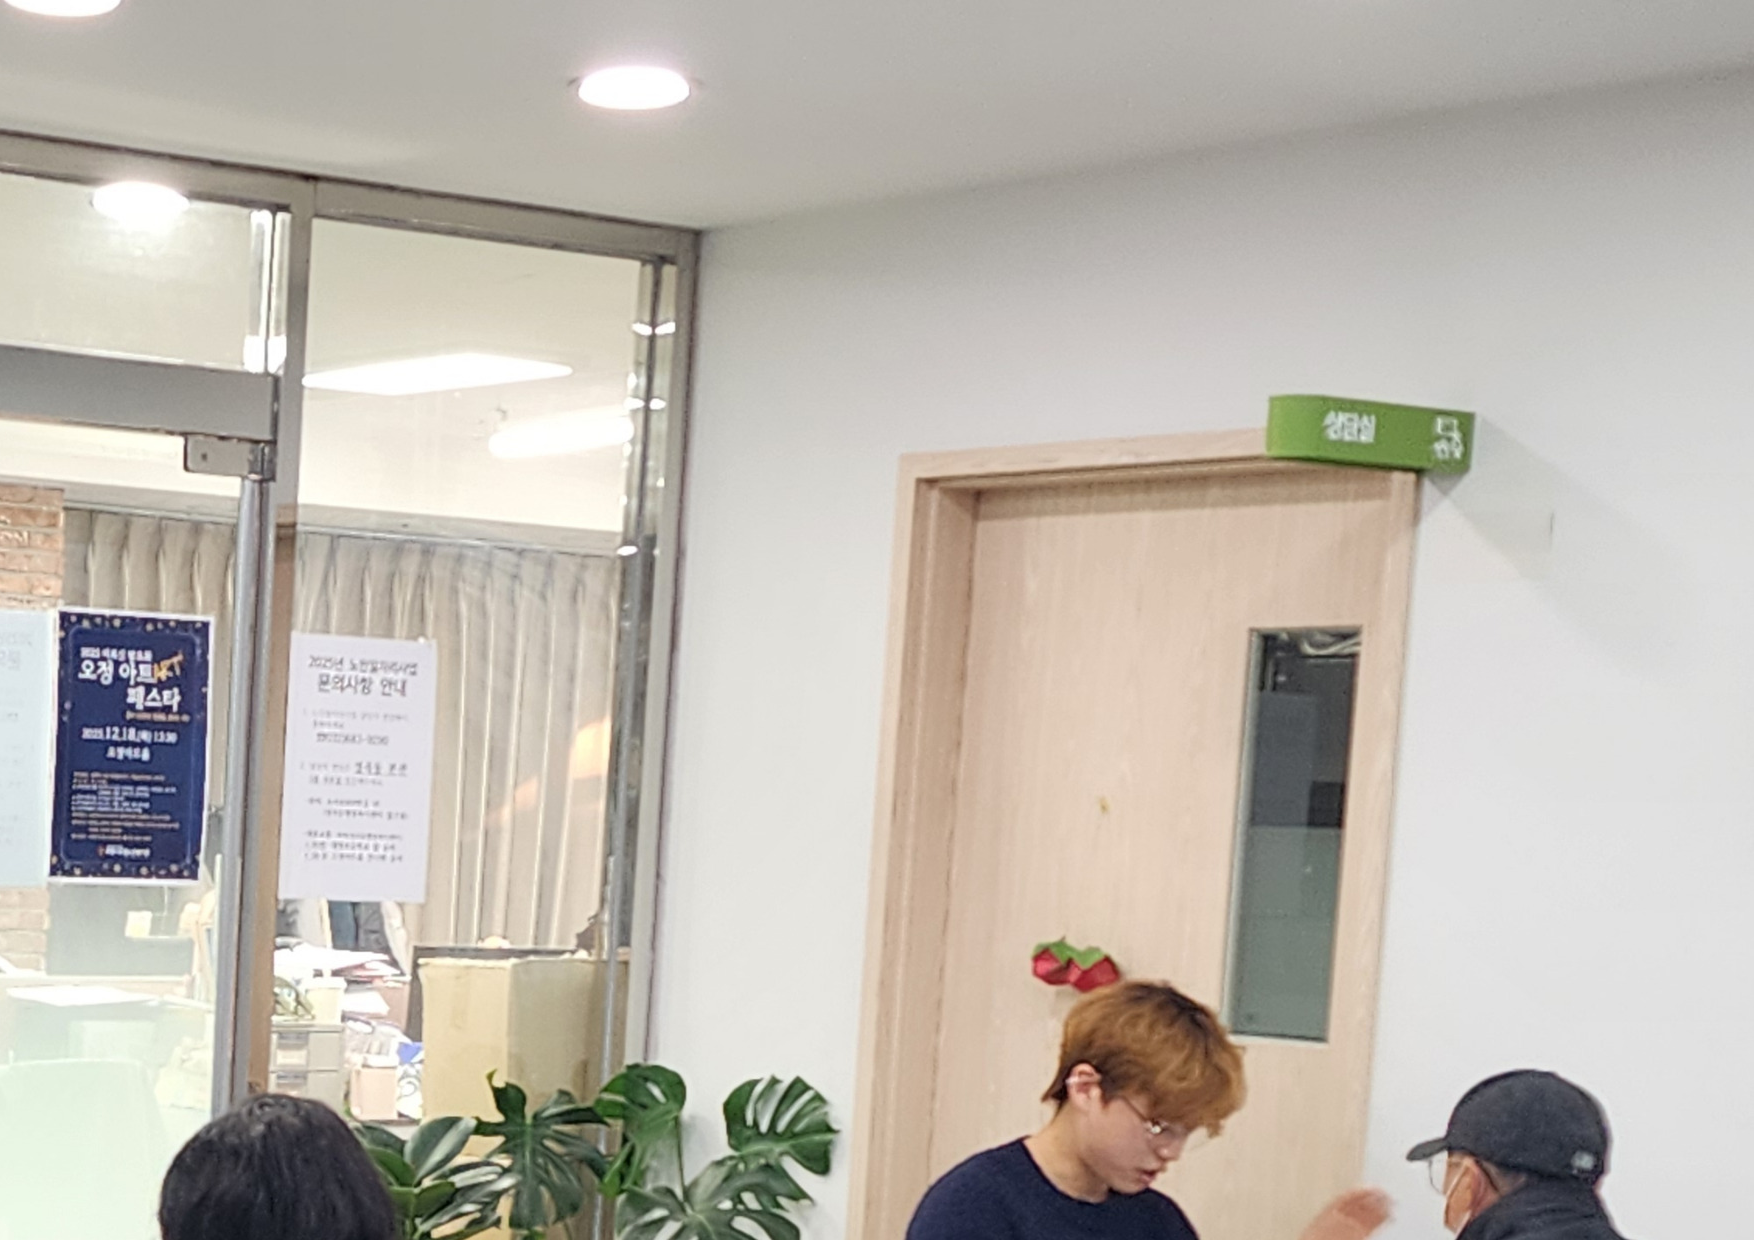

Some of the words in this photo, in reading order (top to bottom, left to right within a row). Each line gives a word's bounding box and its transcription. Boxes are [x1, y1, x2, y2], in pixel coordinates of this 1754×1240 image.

[1323, 411, 1376, 443] 상담실
[78, 659, 114, 685] 오정
[119, 660, 158, 686] 아트
[318, 673, 374, 695] 문의사항
[380, 677, 407, 697] 안내
[126, 685, 182, 713] 페스타
